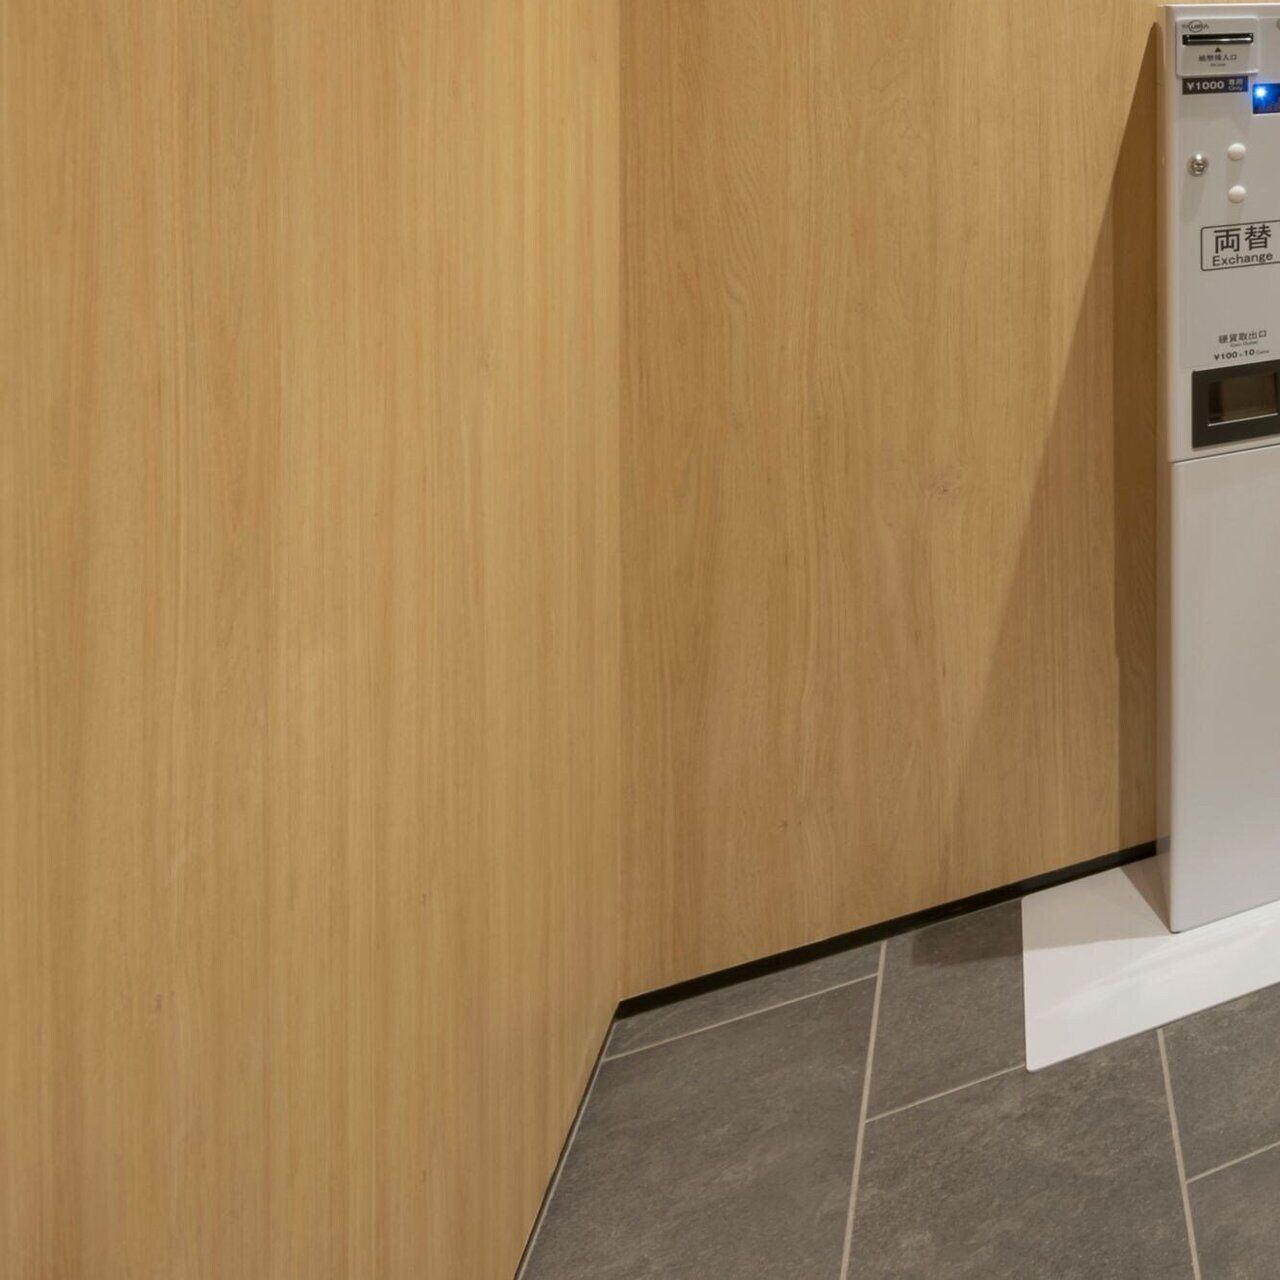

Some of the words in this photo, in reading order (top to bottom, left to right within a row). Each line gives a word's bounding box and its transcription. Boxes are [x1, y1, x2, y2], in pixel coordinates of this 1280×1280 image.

[1187, 81, 1225, 91] ¥1000
[1213, 224, 1272, 254] 両替
[1212, 252, 1273, 267] Exchange
[1218, 330, 1267, 344] 硬貨取出口
[1244, 349, 1255, 357] 10
